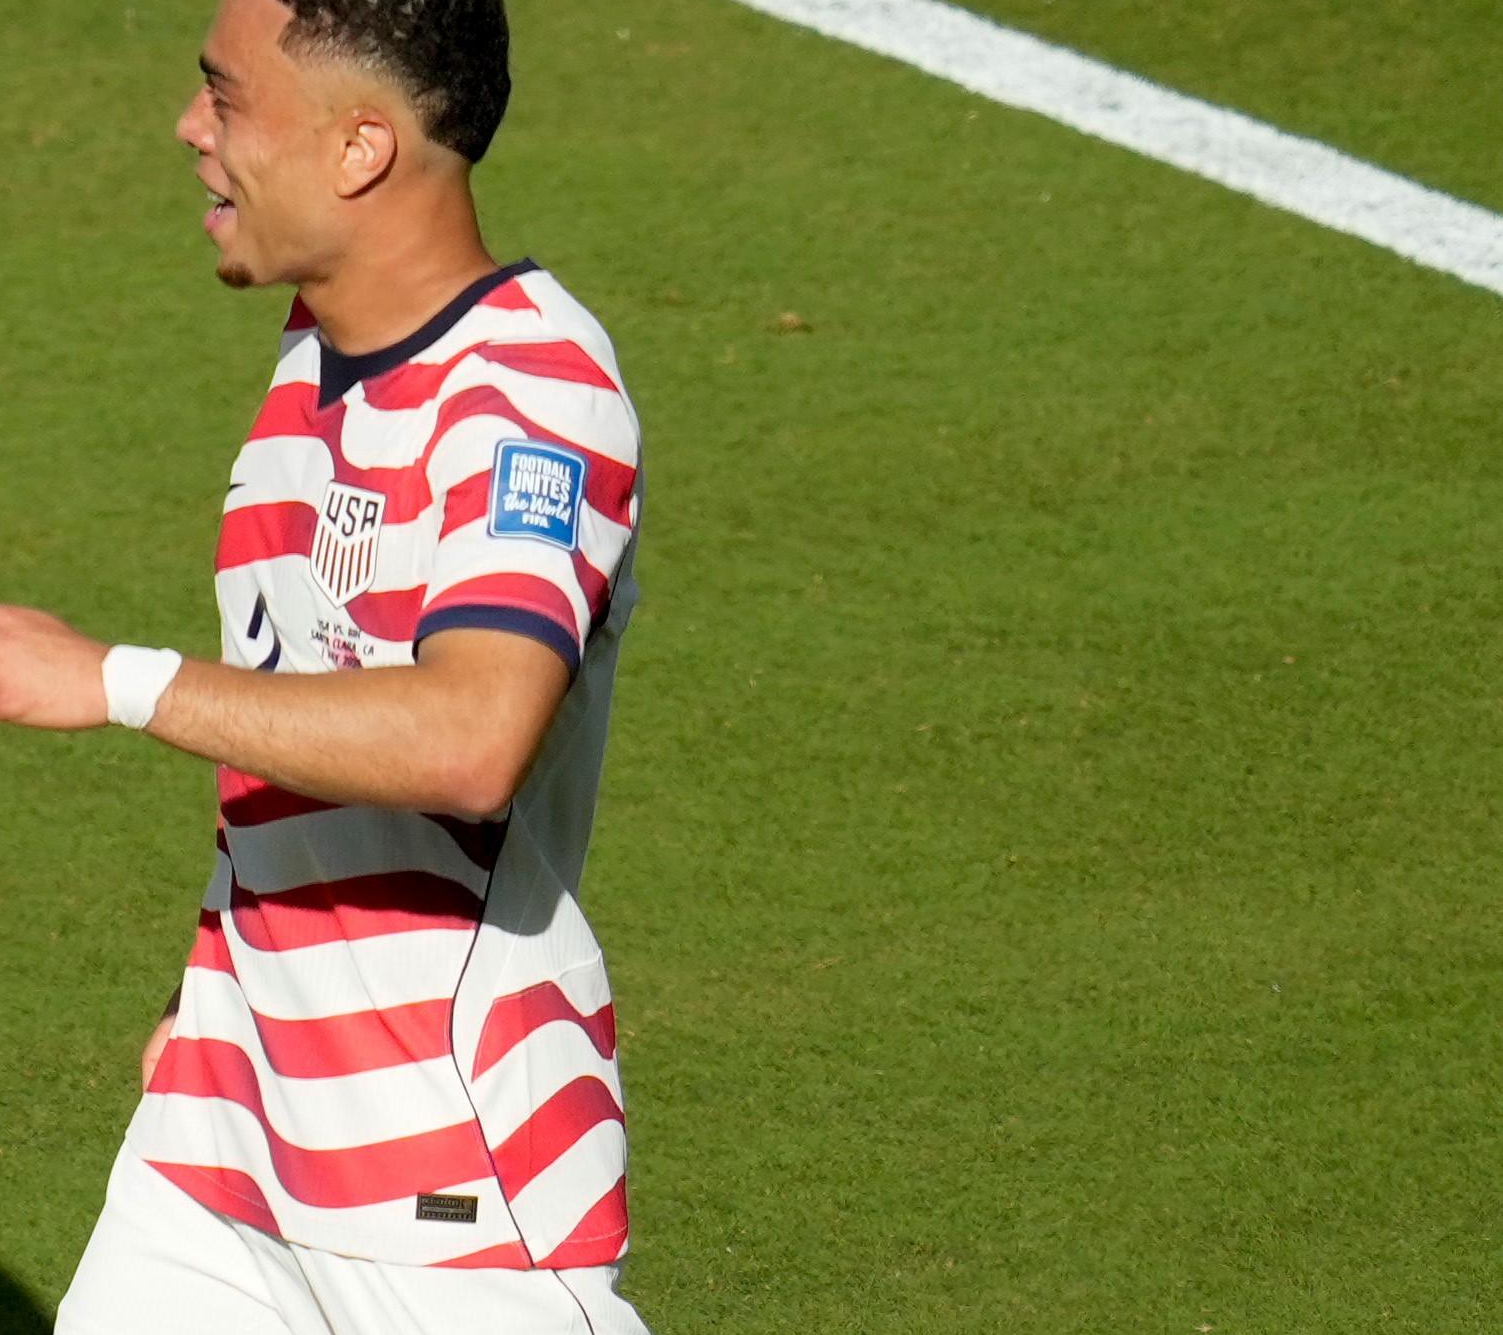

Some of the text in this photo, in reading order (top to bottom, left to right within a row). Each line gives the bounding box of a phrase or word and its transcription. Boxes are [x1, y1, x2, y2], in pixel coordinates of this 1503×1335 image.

[511, 452, 572, 484] FOOTBALL
[509, 470, 571, 505] UNITES
[326, 490, 379, 537] USA
[502, 491, 572, 526] the World
[521, 513, 550, 529] FIFA
[363, 643, 375, 657] CA
